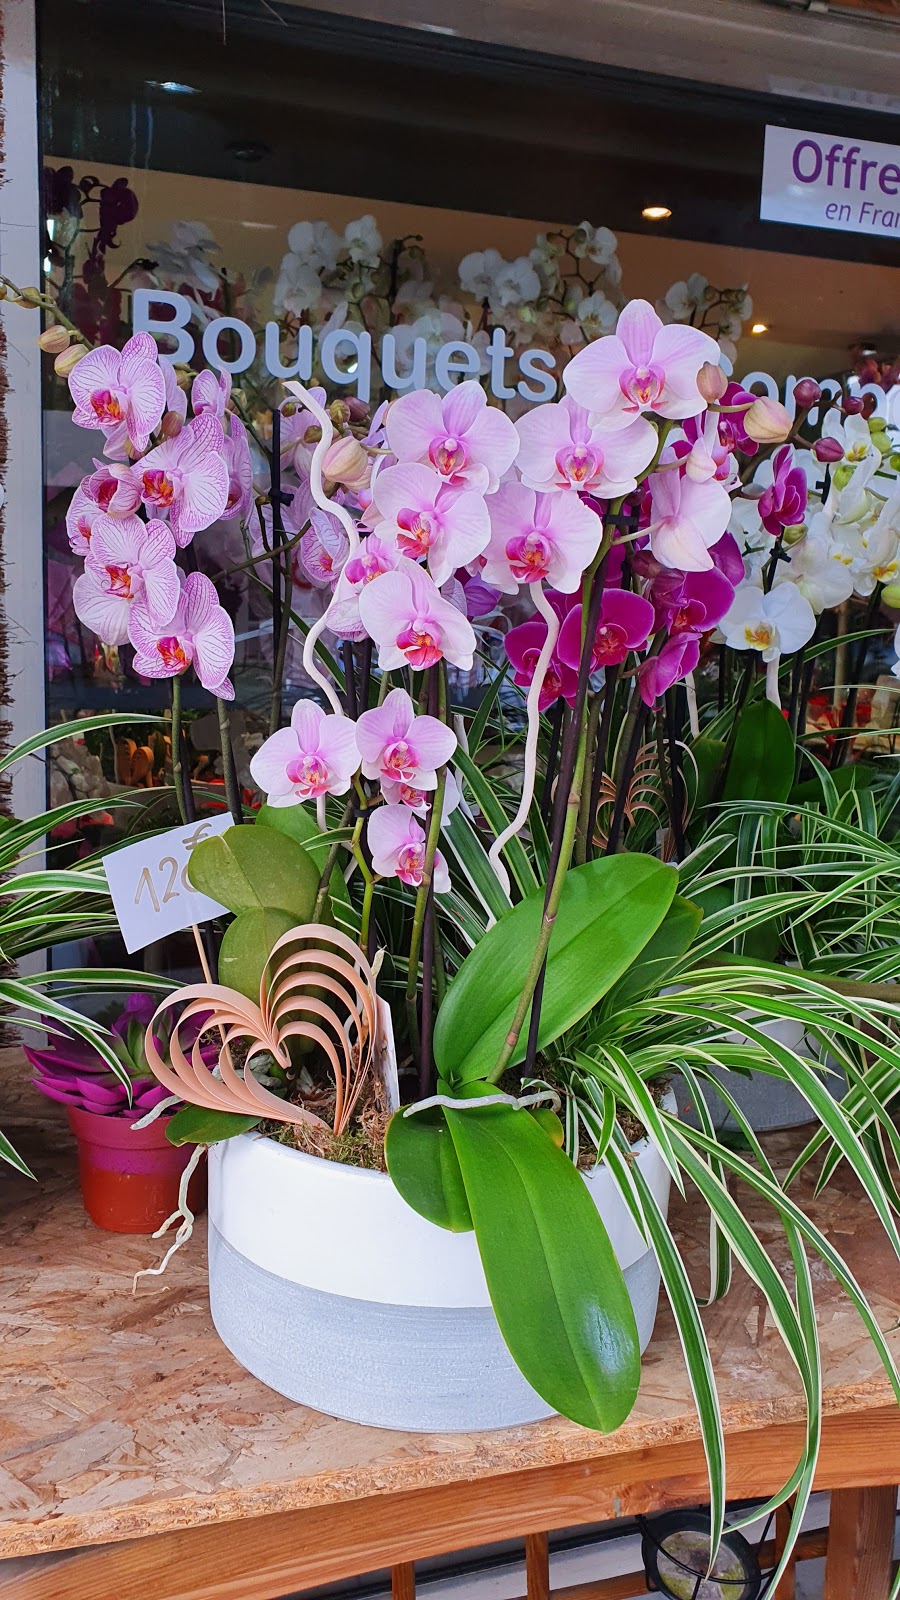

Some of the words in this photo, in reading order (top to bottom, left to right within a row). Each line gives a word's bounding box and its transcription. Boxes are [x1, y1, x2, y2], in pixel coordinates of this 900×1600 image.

[792, 139, 900, 195] Offre
[825, 202, 851, 222] en
[132, 288, 558, 402] Bouquets
